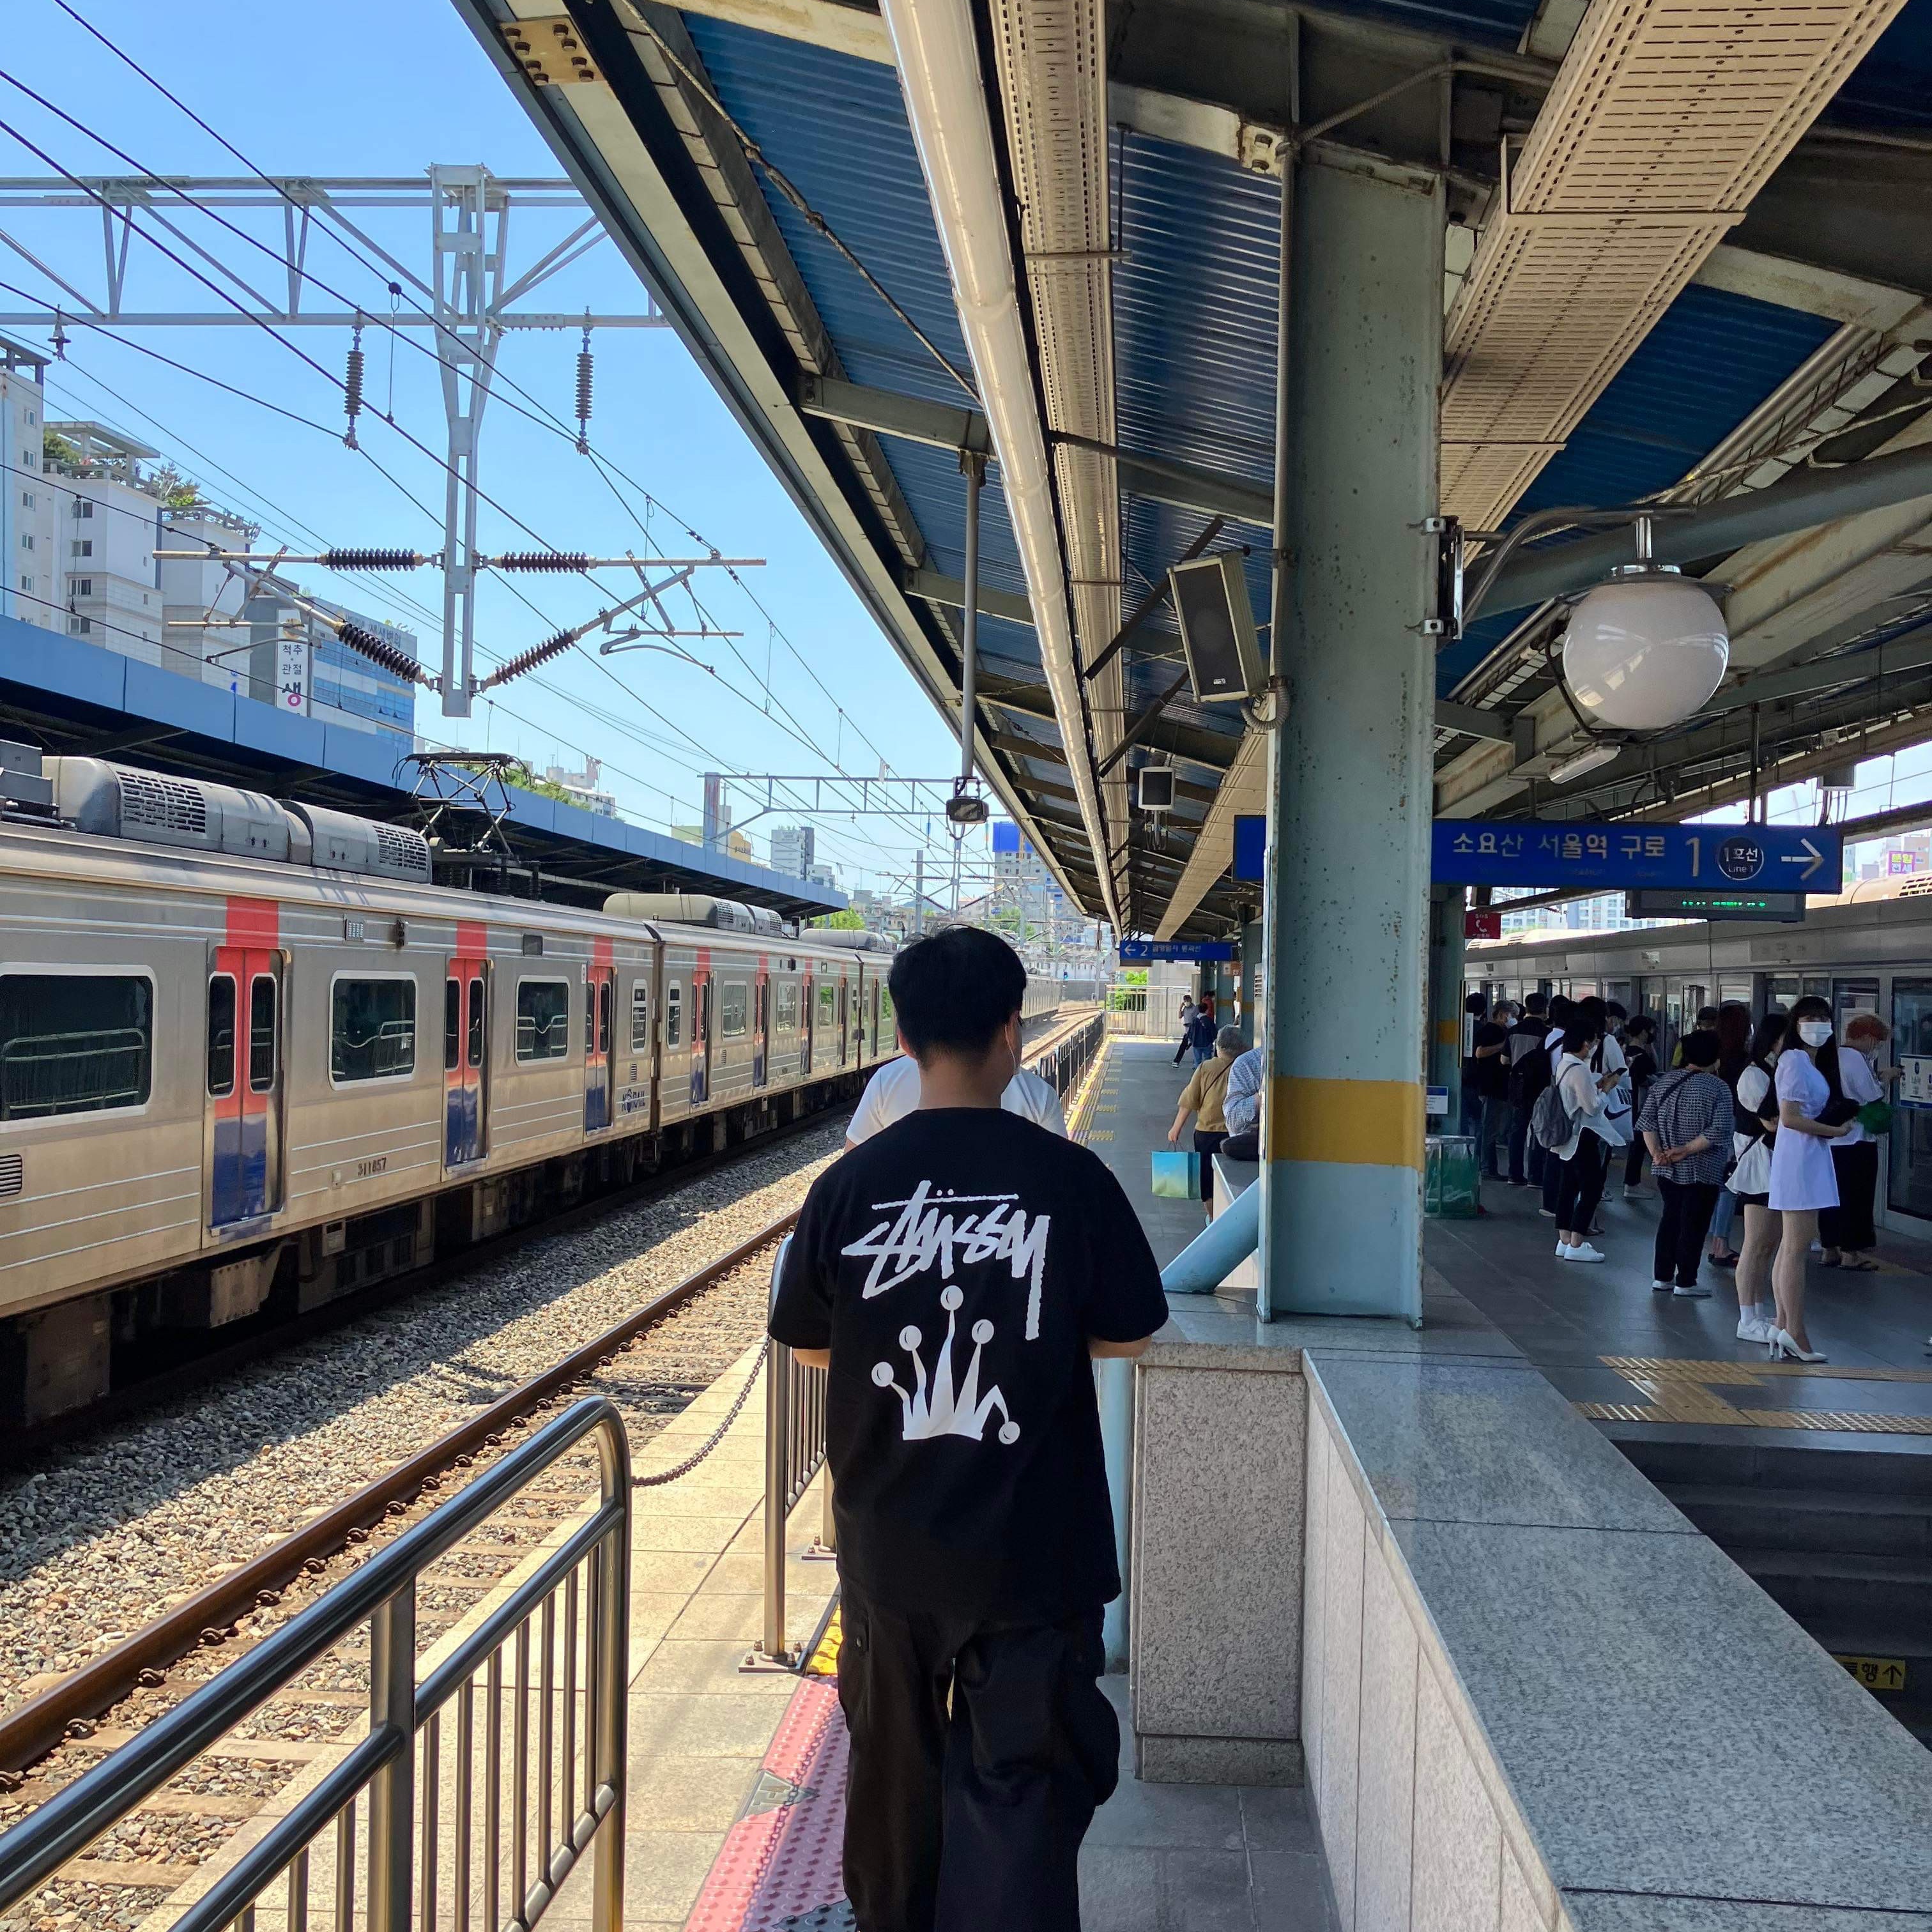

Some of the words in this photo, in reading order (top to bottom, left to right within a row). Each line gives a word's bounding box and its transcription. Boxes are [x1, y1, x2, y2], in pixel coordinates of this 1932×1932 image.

[282, 644, 302, 656] 척추
[282, 664, 302, 675] 관절
[1452, 832, 1524, 857] 소요산
[1538, 832, 1607, 859] 서울역
[1620, 835, 1666, 860] 구로
[1685, 837, 1700, 877] 1
[1724, 847, 1758, 862] 1호선
[1728, 864, 1747, 873] Line
[1749, 864, 1754, 873] 1
[1139, 944, 1149, 956] 2
